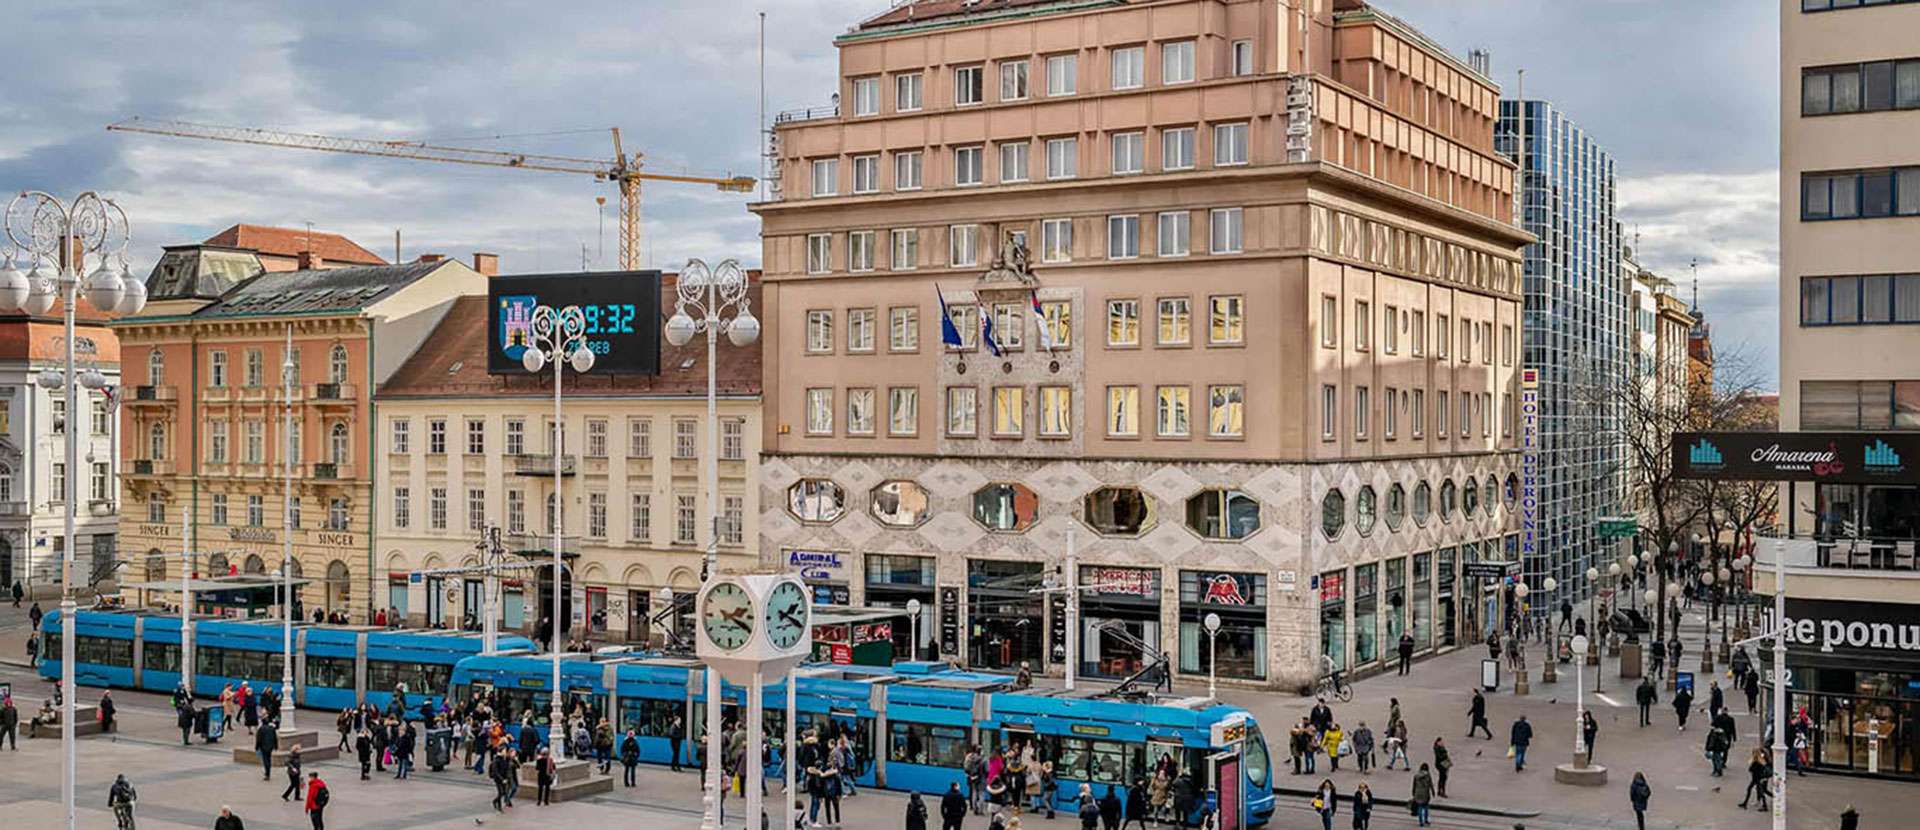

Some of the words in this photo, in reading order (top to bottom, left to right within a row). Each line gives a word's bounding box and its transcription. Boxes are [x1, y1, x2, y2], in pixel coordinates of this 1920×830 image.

[1523, 392, 1536, 448] HOTEL
[1751, 443, 1835, 462] Amarena
[1523, 454, 1536, 553] DUBROVNIK
[139, 525, 169, 536] SINGER
[318, 533, 354, 546] SINGER
